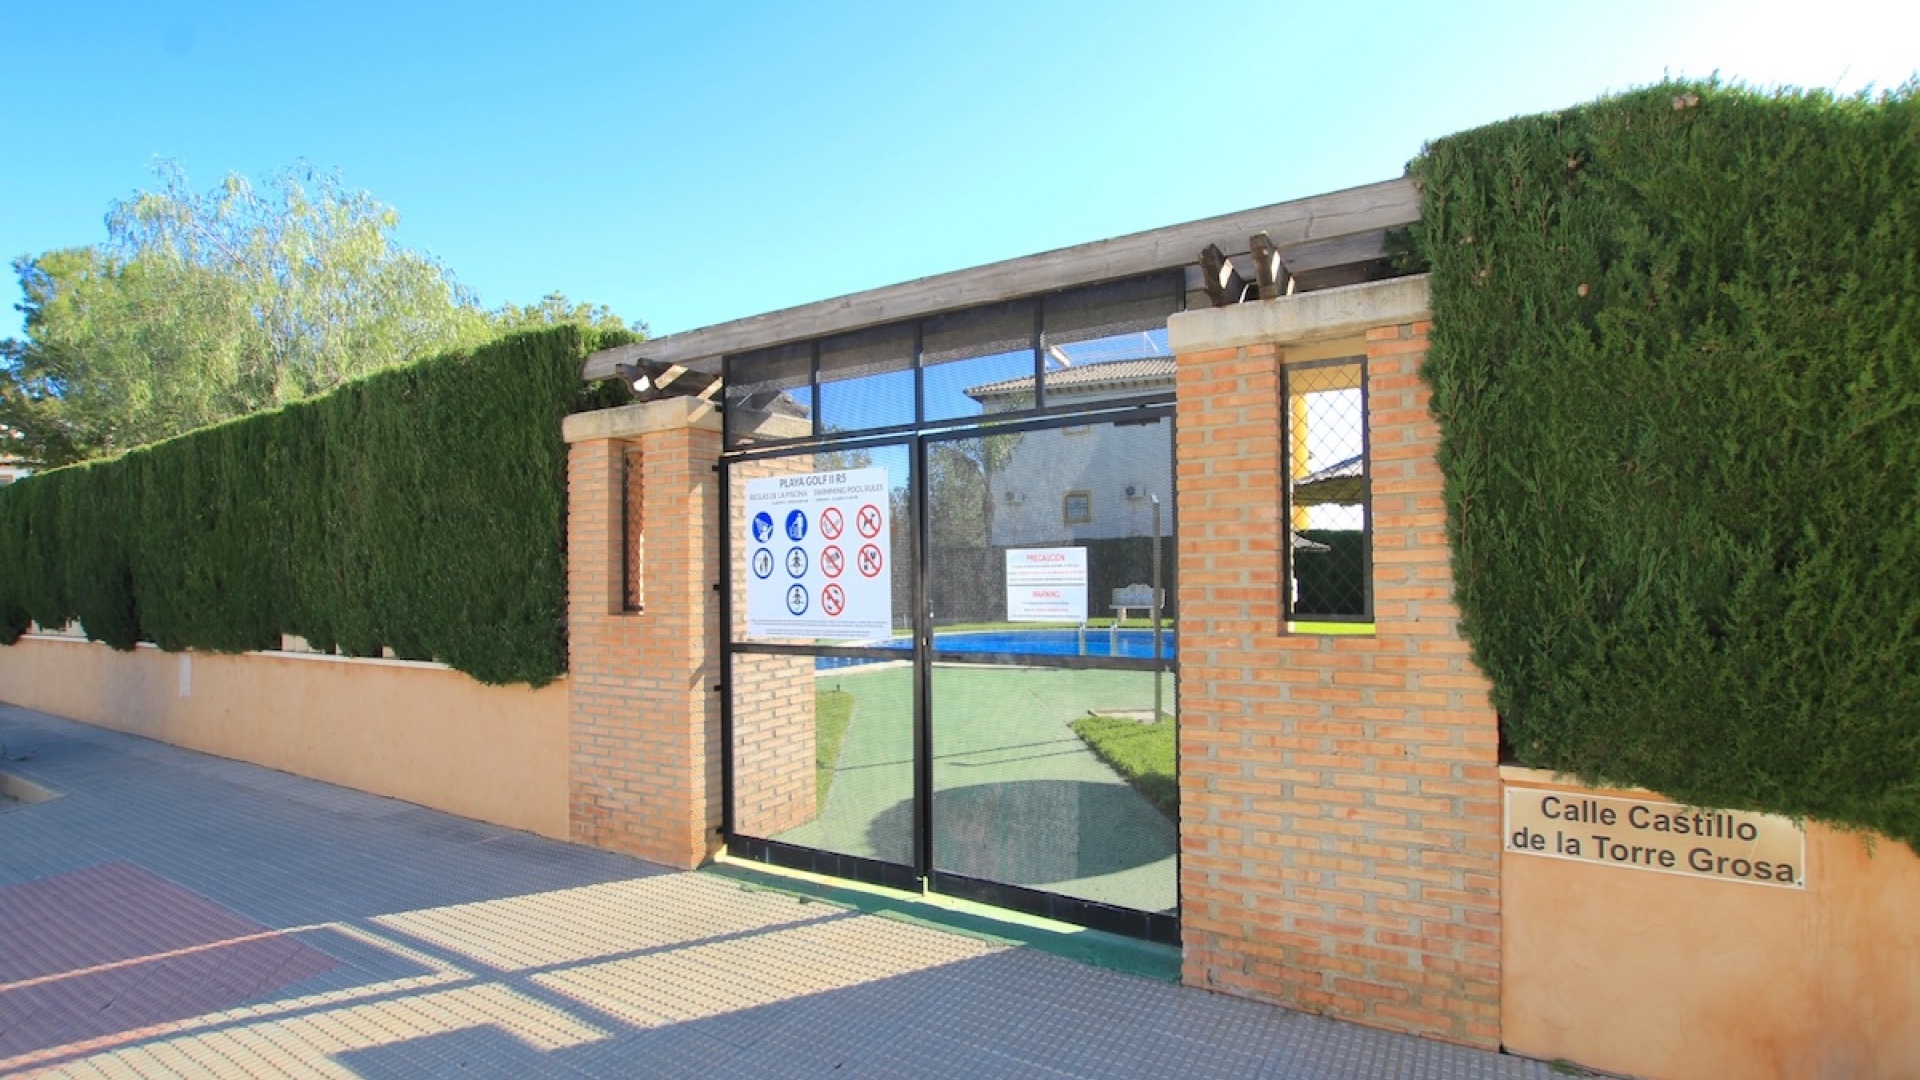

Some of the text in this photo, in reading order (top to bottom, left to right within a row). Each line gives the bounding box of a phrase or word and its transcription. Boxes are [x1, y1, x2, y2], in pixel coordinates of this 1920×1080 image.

[779, 477, 805, 488] PLAYA
[806, 475, 828, 486] GOLF
[828, 474, 835, 485] II
[750, 490, 807, 500] REGLAS DE LA PISCINA
[813, 484, 883, 496] SWIMMING POOL RULES
[1026, 552, 1065, 562] PRECAUCIÓN
[1032, 590, 1060, 598] WARNING
[1541, 796, 1758, 842] Calle Castillo
[1512, 827, 1795, 883] de la Torre Grosa
